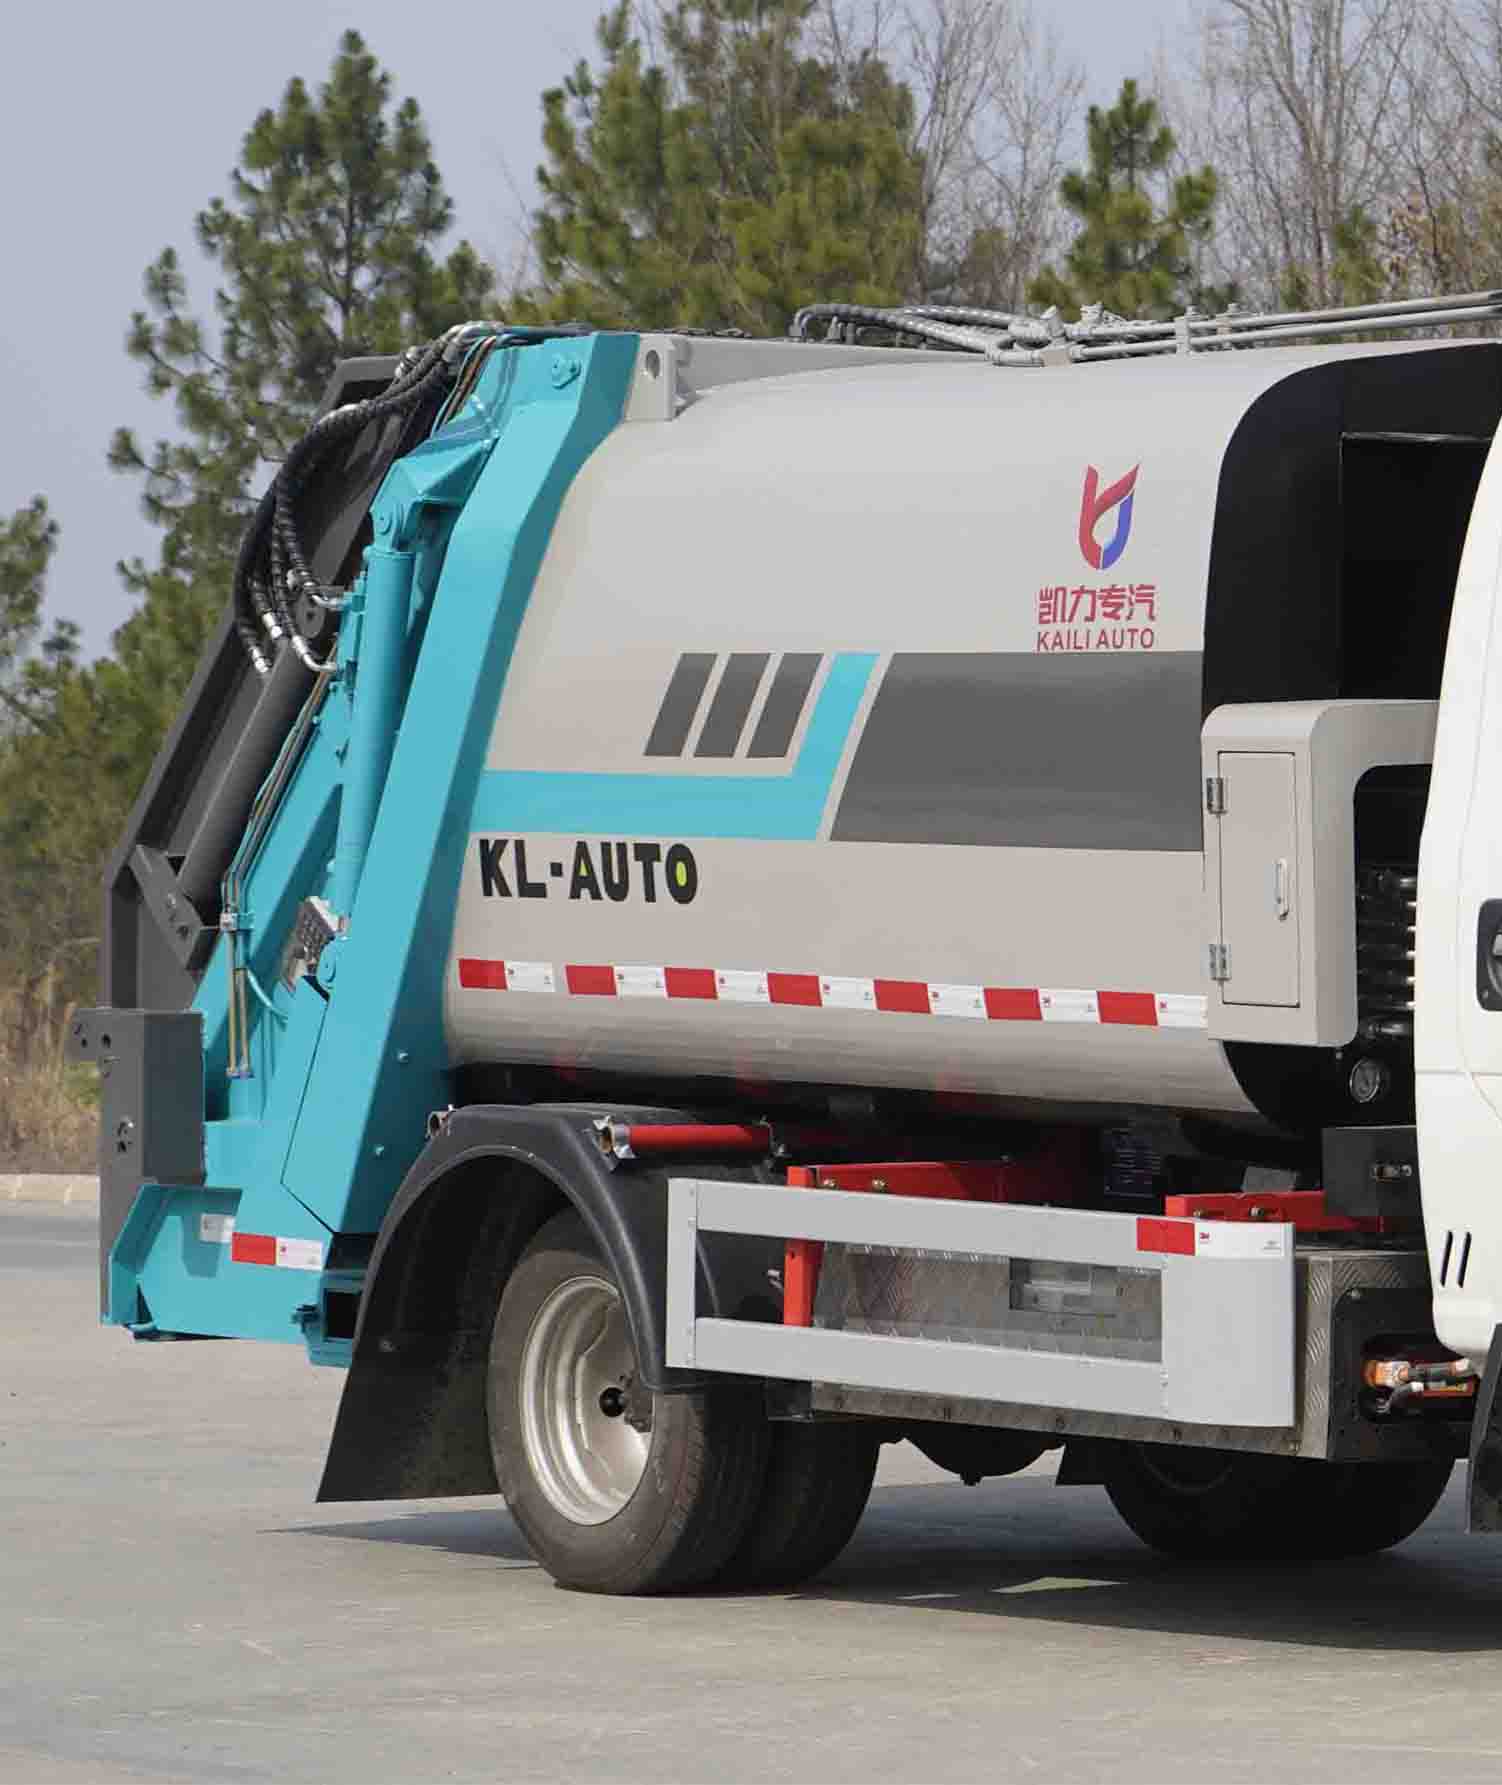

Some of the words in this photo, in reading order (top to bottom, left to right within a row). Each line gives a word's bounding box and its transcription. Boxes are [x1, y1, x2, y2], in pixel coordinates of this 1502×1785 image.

[1038, 584, 1156, 624] 凯力专汽
[1037, 630, 1090, 651] KAILI
[1096, 628, 1155, 649] AUTO
[479, 839, 698, 904] KL-AUTO
